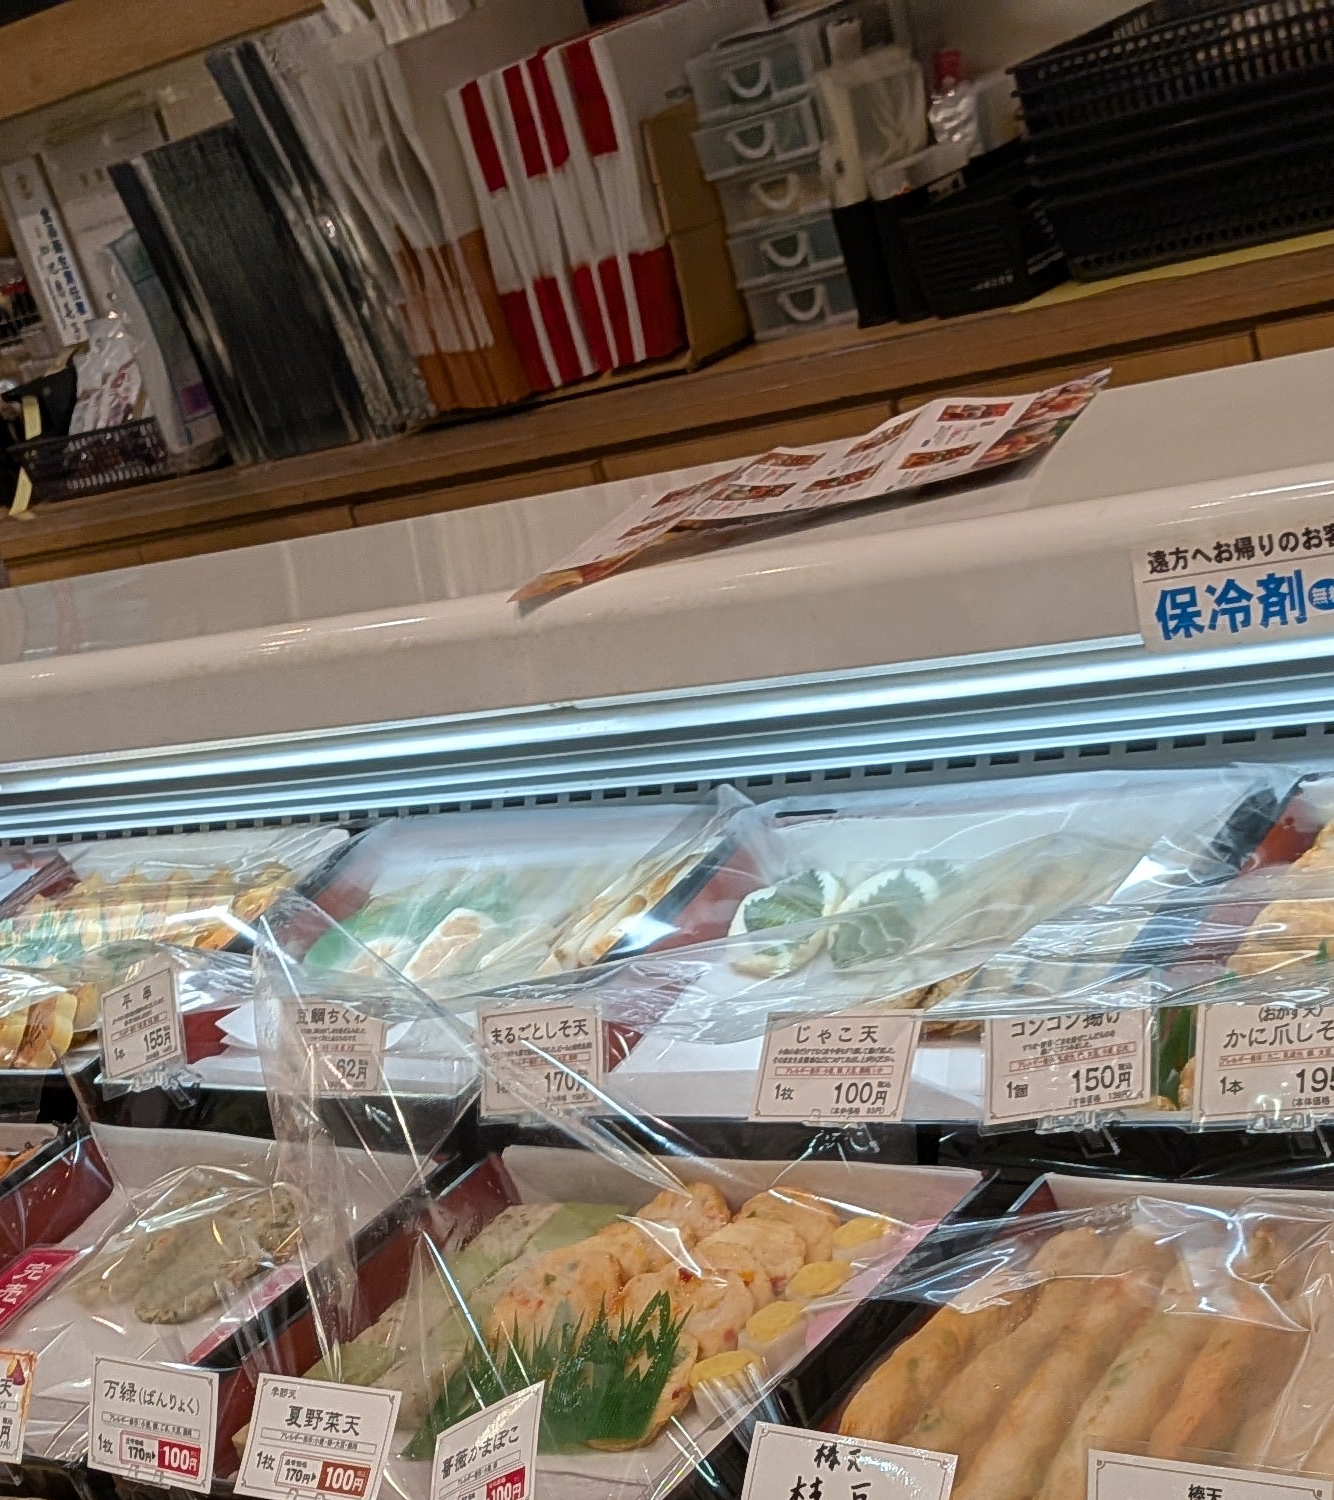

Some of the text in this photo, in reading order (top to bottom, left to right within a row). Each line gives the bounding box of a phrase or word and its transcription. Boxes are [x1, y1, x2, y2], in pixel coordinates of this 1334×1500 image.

[1154, 568, 1308, 641] 保冷剤
[491, 1018, 589, 1045] まるごとしそ天
[796, 1025, 880, 1045] じゃこ天
[1072, 1064, 1132, 1094] 150円
[1219, 1076, 1245, 1096] 1本
[774, 1083, 795, 1101] 1枚
[834, 1081, 888, 1106] 100円
[103, 1378, 201, 1417] 万緑(ばんりょく)
[284, 1404, 363, 1437] 夏野菜天
[161, 1446, 198, 1472] 100円
[256, 1450, 276, 1473] 1枚
[324, 1466, 365, 1493] 100円
